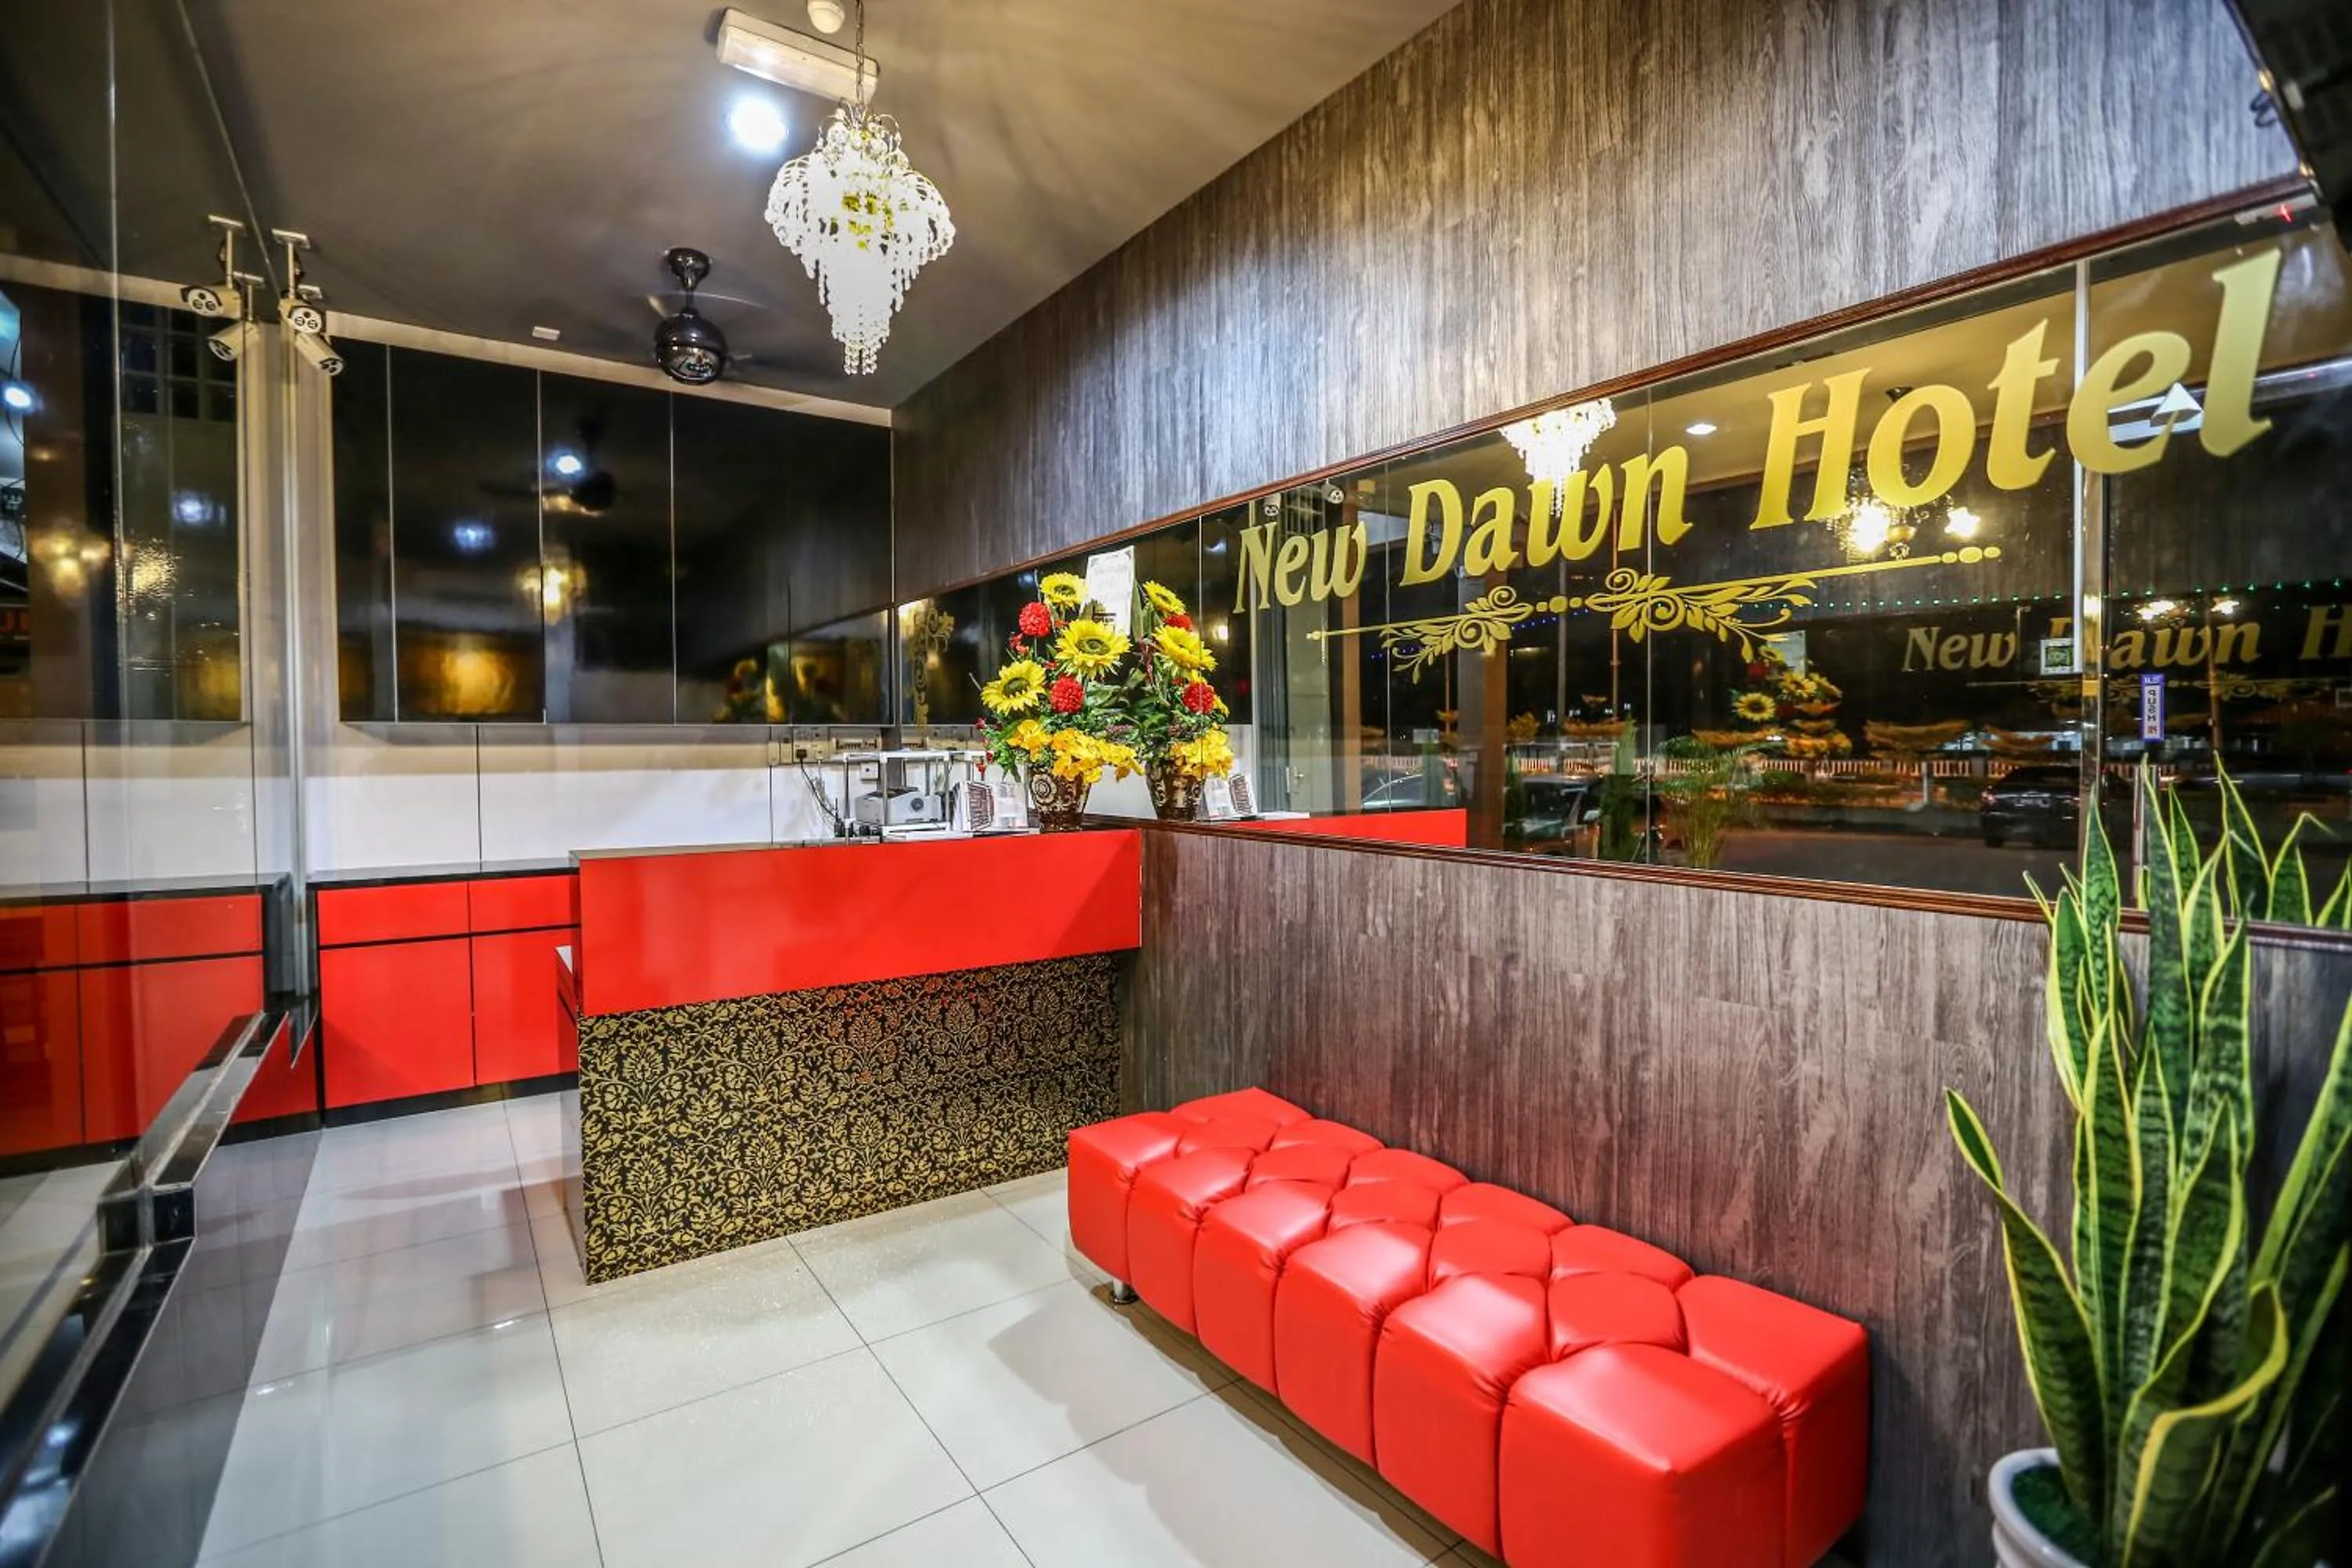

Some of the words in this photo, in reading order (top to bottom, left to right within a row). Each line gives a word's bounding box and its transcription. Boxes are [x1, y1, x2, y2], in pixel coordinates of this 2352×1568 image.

[1233, 520, 1368, 615] New
[1399, 445, 1693, 588] Dawn
[1749, 247, 2281, 531] Hotel
[1901, 626, 2017, 673] New
